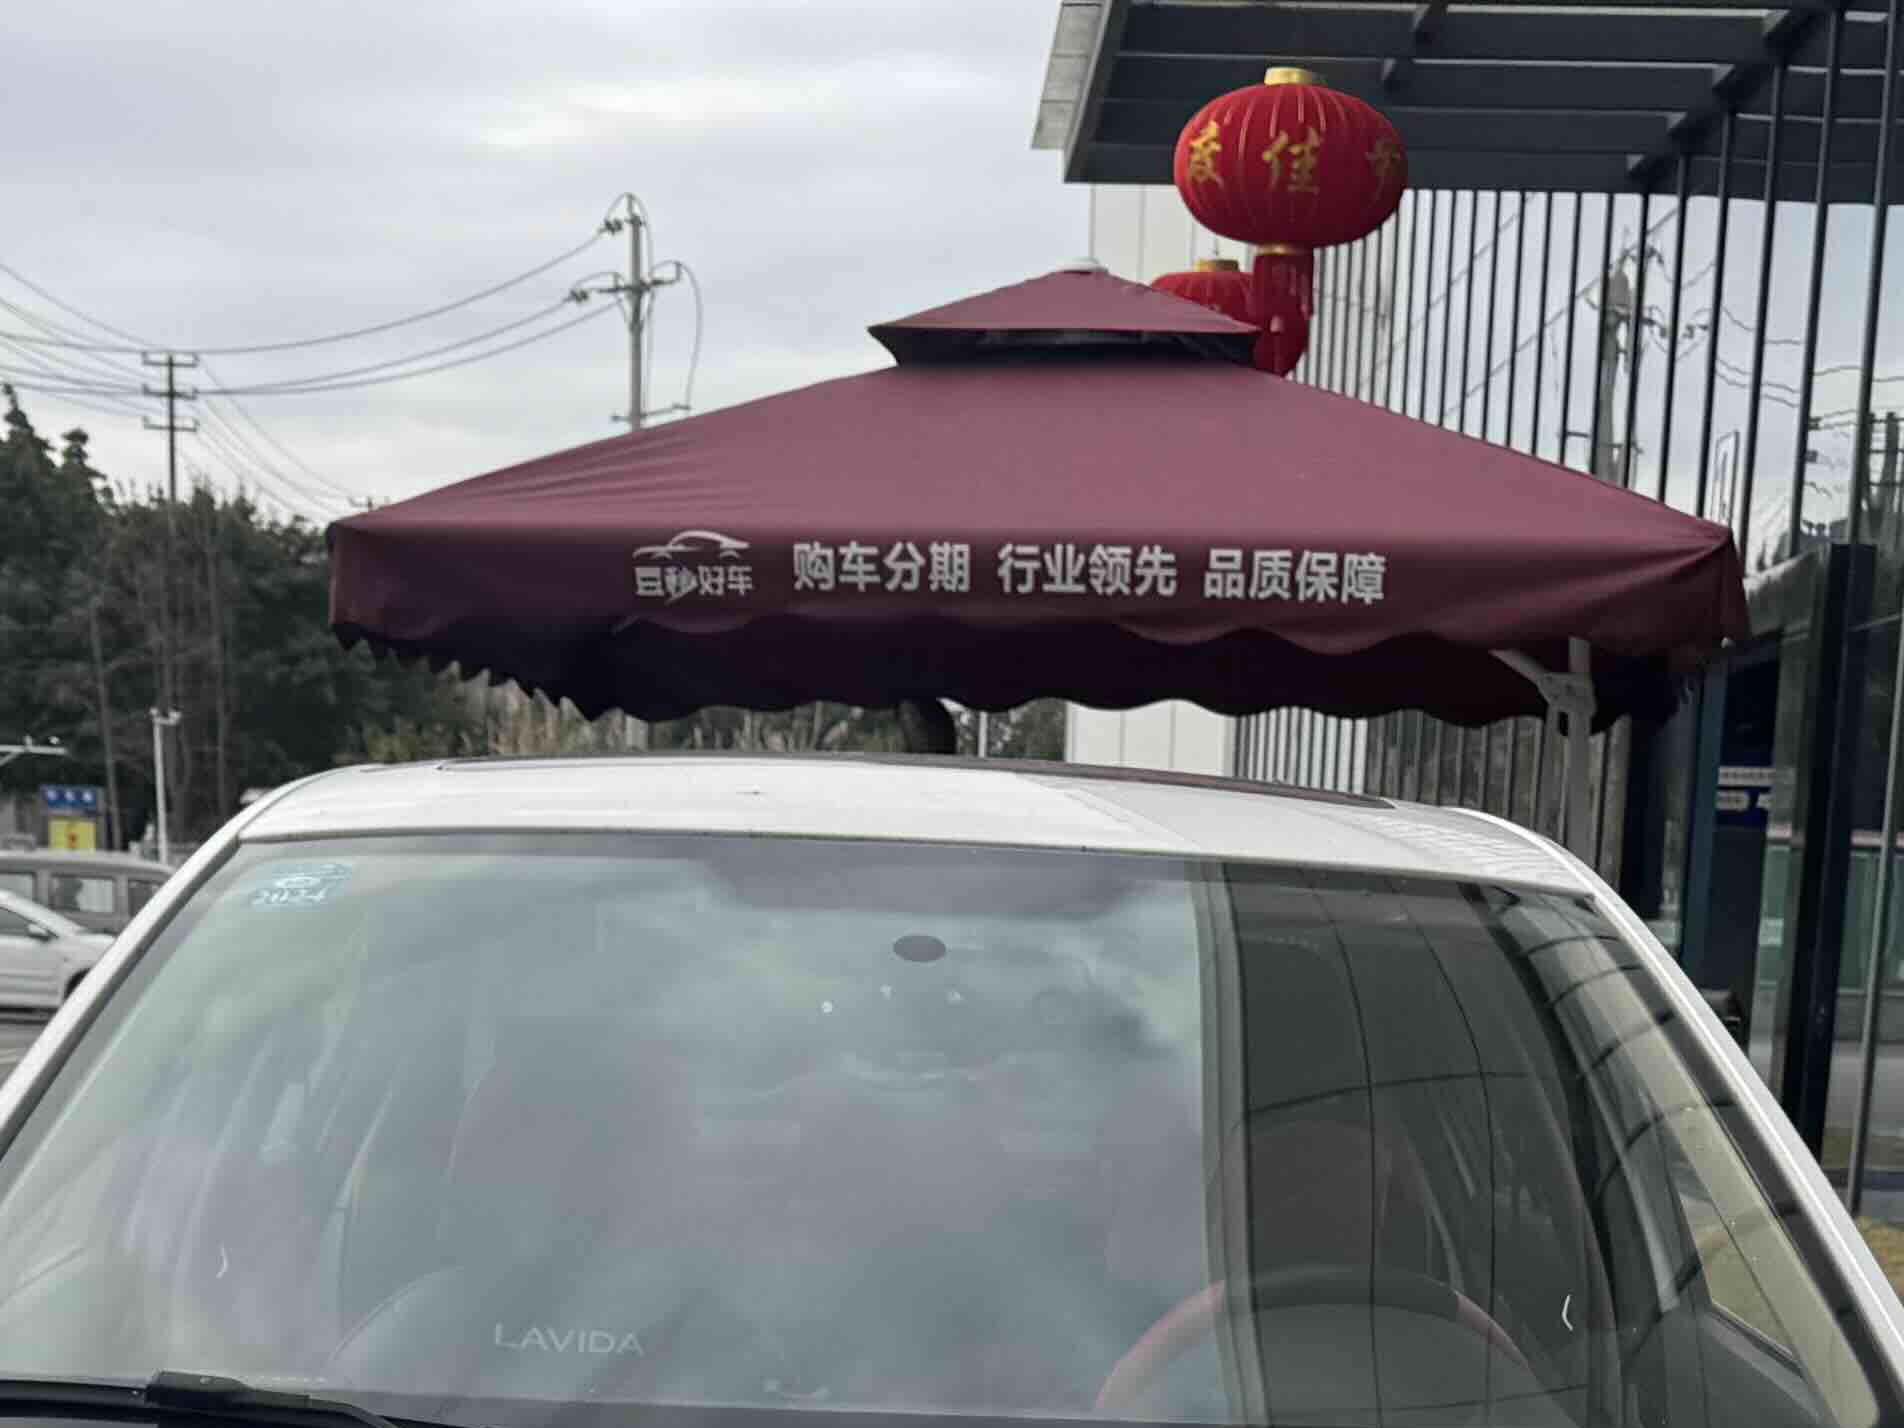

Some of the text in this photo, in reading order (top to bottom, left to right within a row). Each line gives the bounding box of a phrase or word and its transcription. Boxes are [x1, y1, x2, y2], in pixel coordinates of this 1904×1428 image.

[793, 543, 971, 592] 购车分期
[997, 544, 1177, 596] 行业领先
[1203, 548, 1386, 605] 品质保障
[493, 1322, 646, 1358] LAVIDA
